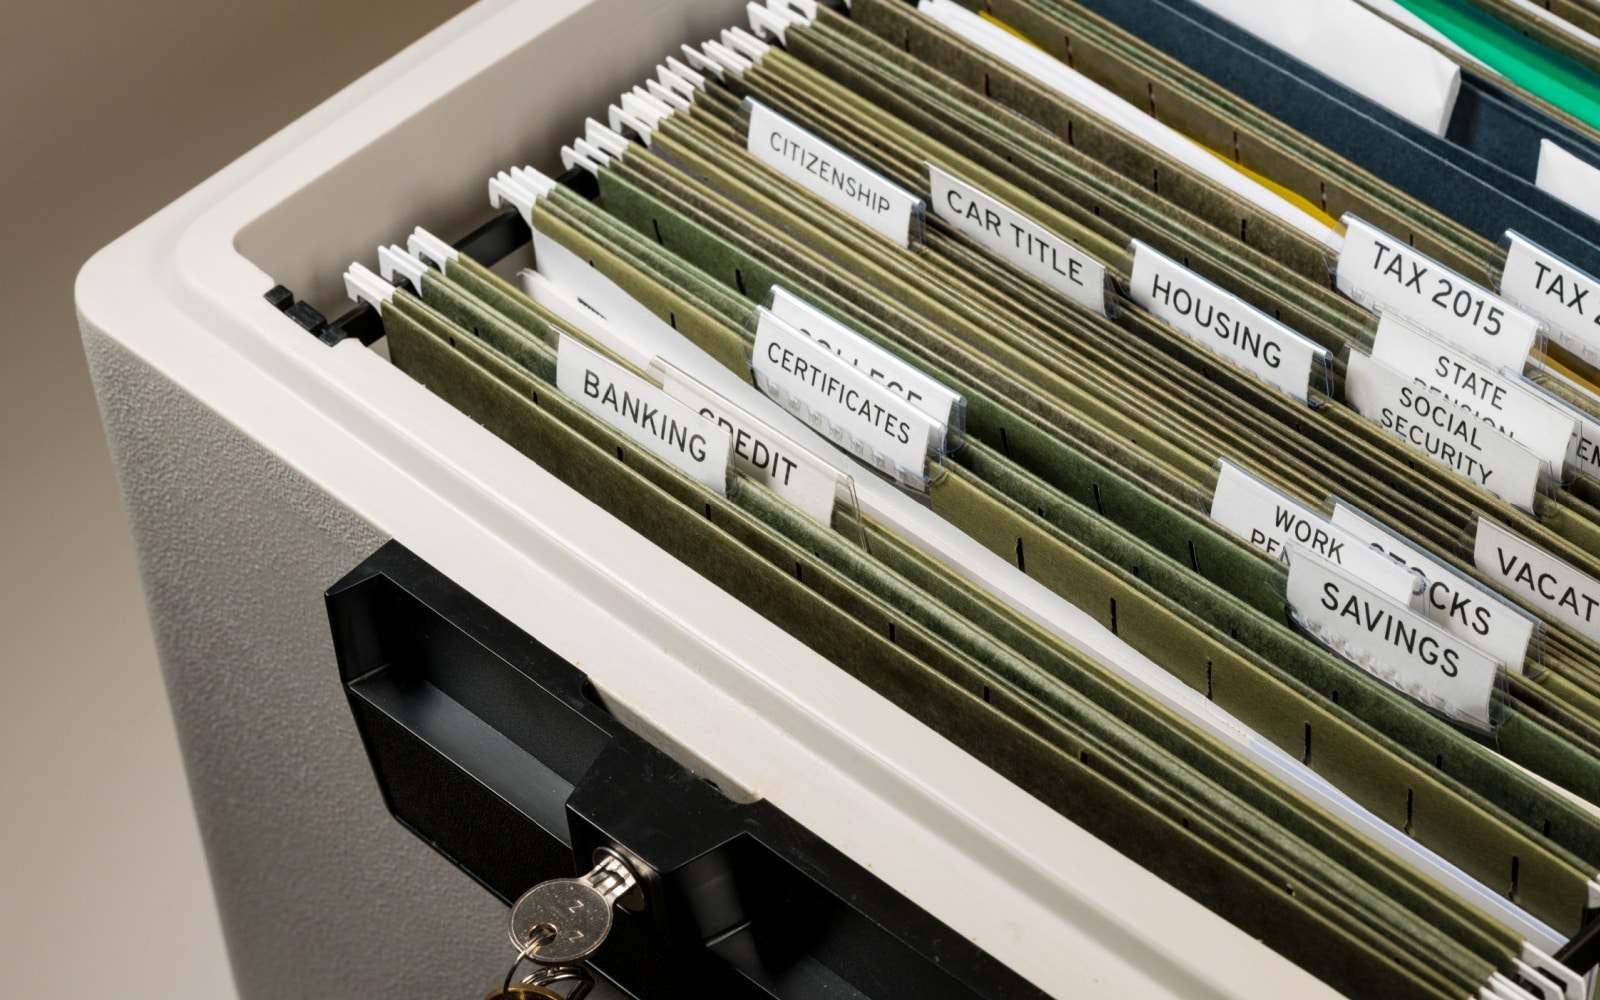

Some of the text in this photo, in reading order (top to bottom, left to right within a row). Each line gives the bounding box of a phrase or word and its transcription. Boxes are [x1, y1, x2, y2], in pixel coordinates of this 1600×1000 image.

[769, 131, 891, 215] CITIZENSHIP
[946, 190, 1084, 286] CAR TITLE
[1151, 273, 1282, 369] HOUSING
[1373, 240, 1505, 336] TAX 2015
[1534, 261, 1590, 315] TAX
[583, 368, 707, 463] BANKING
[767, 342, 911, 445] CERTIFICATES
[1399, 386, 1483, 452] SOCIAL
[1435, 355, 1508, 411] STATE
[1381, 407, 1494, 486] SECURITY
[1274, 505, 1345, 565] WORK
[1321, 581, 1460, 678] SAVINGS
